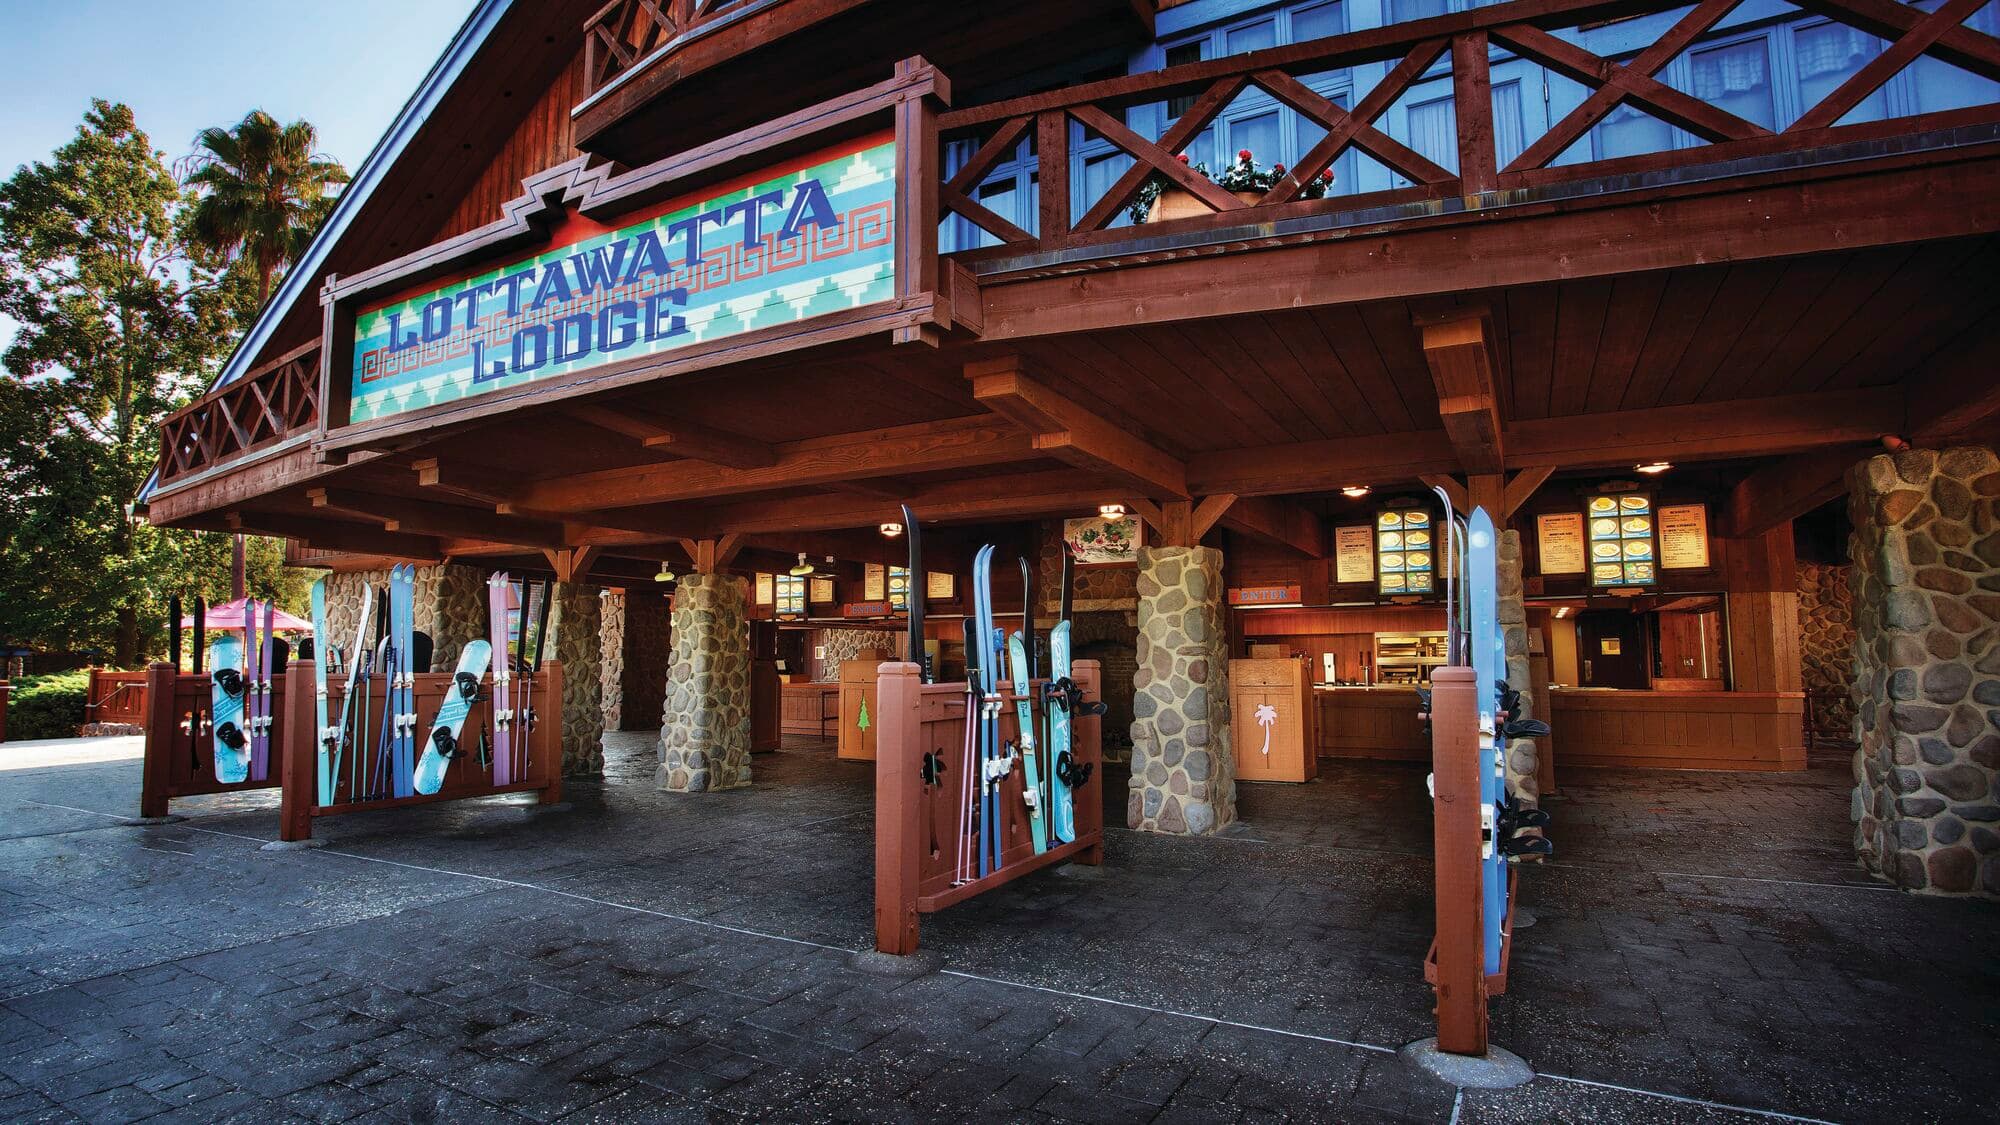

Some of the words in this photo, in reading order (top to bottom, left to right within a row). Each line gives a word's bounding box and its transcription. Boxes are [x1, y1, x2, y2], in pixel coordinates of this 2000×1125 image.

[388, 178, 844, 353] LOTTAWATTA
[471, 287, 690, 385] LODGE
[1241, 589, 1288, 601] ENTER
